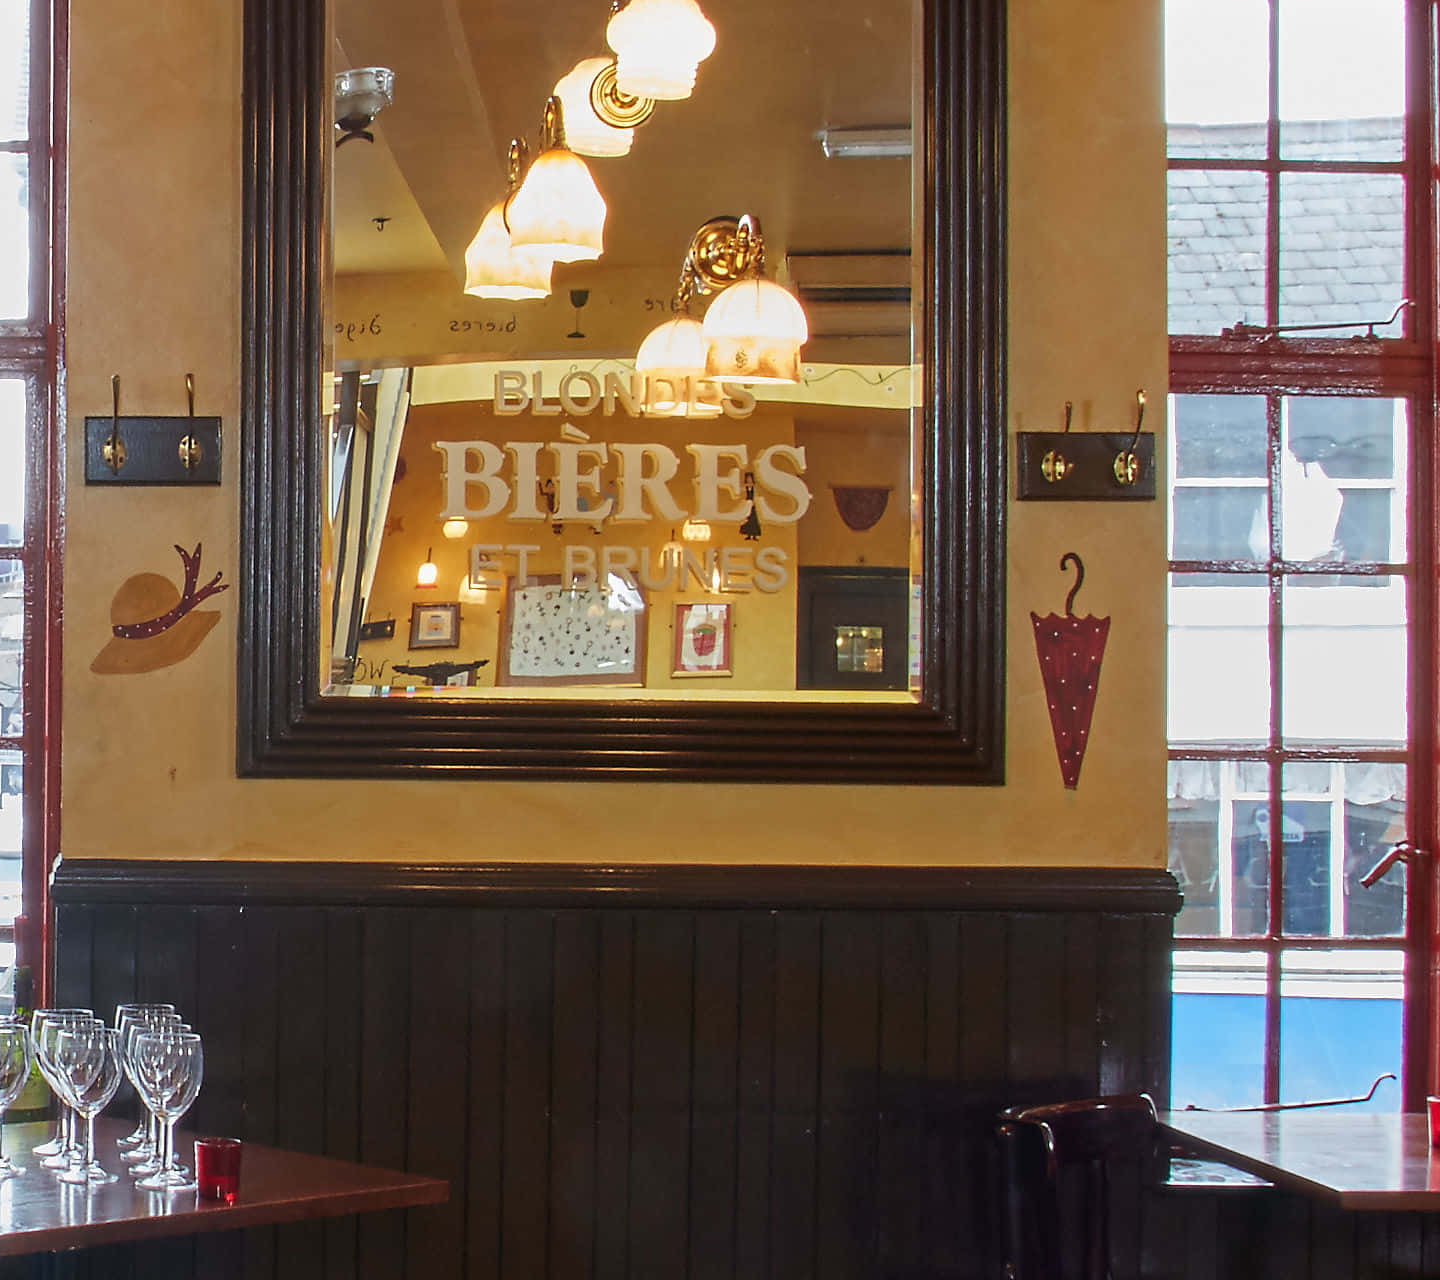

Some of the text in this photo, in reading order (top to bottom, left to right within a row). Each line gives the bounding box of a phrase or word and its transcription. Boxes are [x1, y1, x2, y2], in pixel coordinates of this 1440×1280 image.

[493, 369, 758, 420] BLONDES
[431, 424, 814, 527] BIÈRES
[468, 543, 790, 595] ET BRUNES
